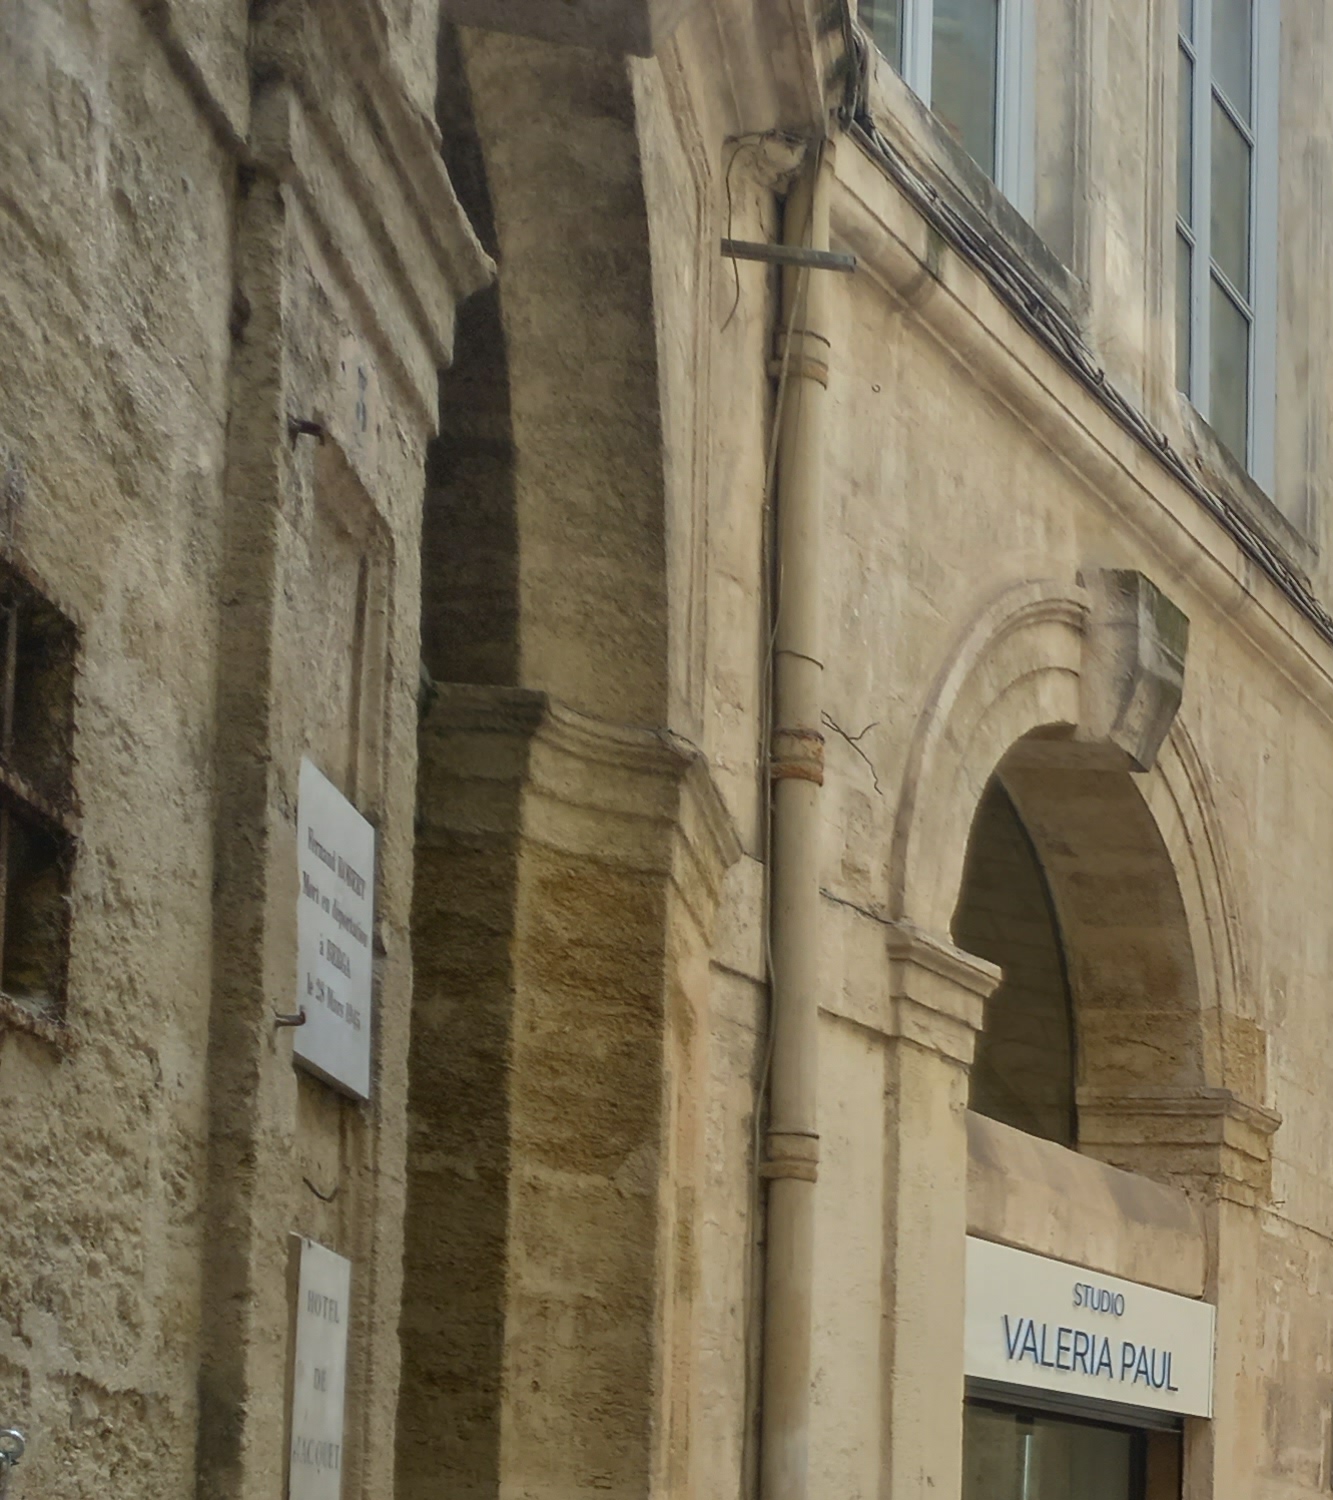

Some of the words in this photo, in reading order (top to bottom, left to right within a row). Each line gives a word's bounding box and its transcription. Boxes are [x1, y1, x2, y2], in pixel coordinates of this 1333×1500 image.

[307, 1290, 340, 1325] HOTEL
[1073, 1281, 1125, 1318] STUDIO
[1003, 1314, 1113, 1379] VALERIA
[1121, 1341, 1179, 1393] PAUL
